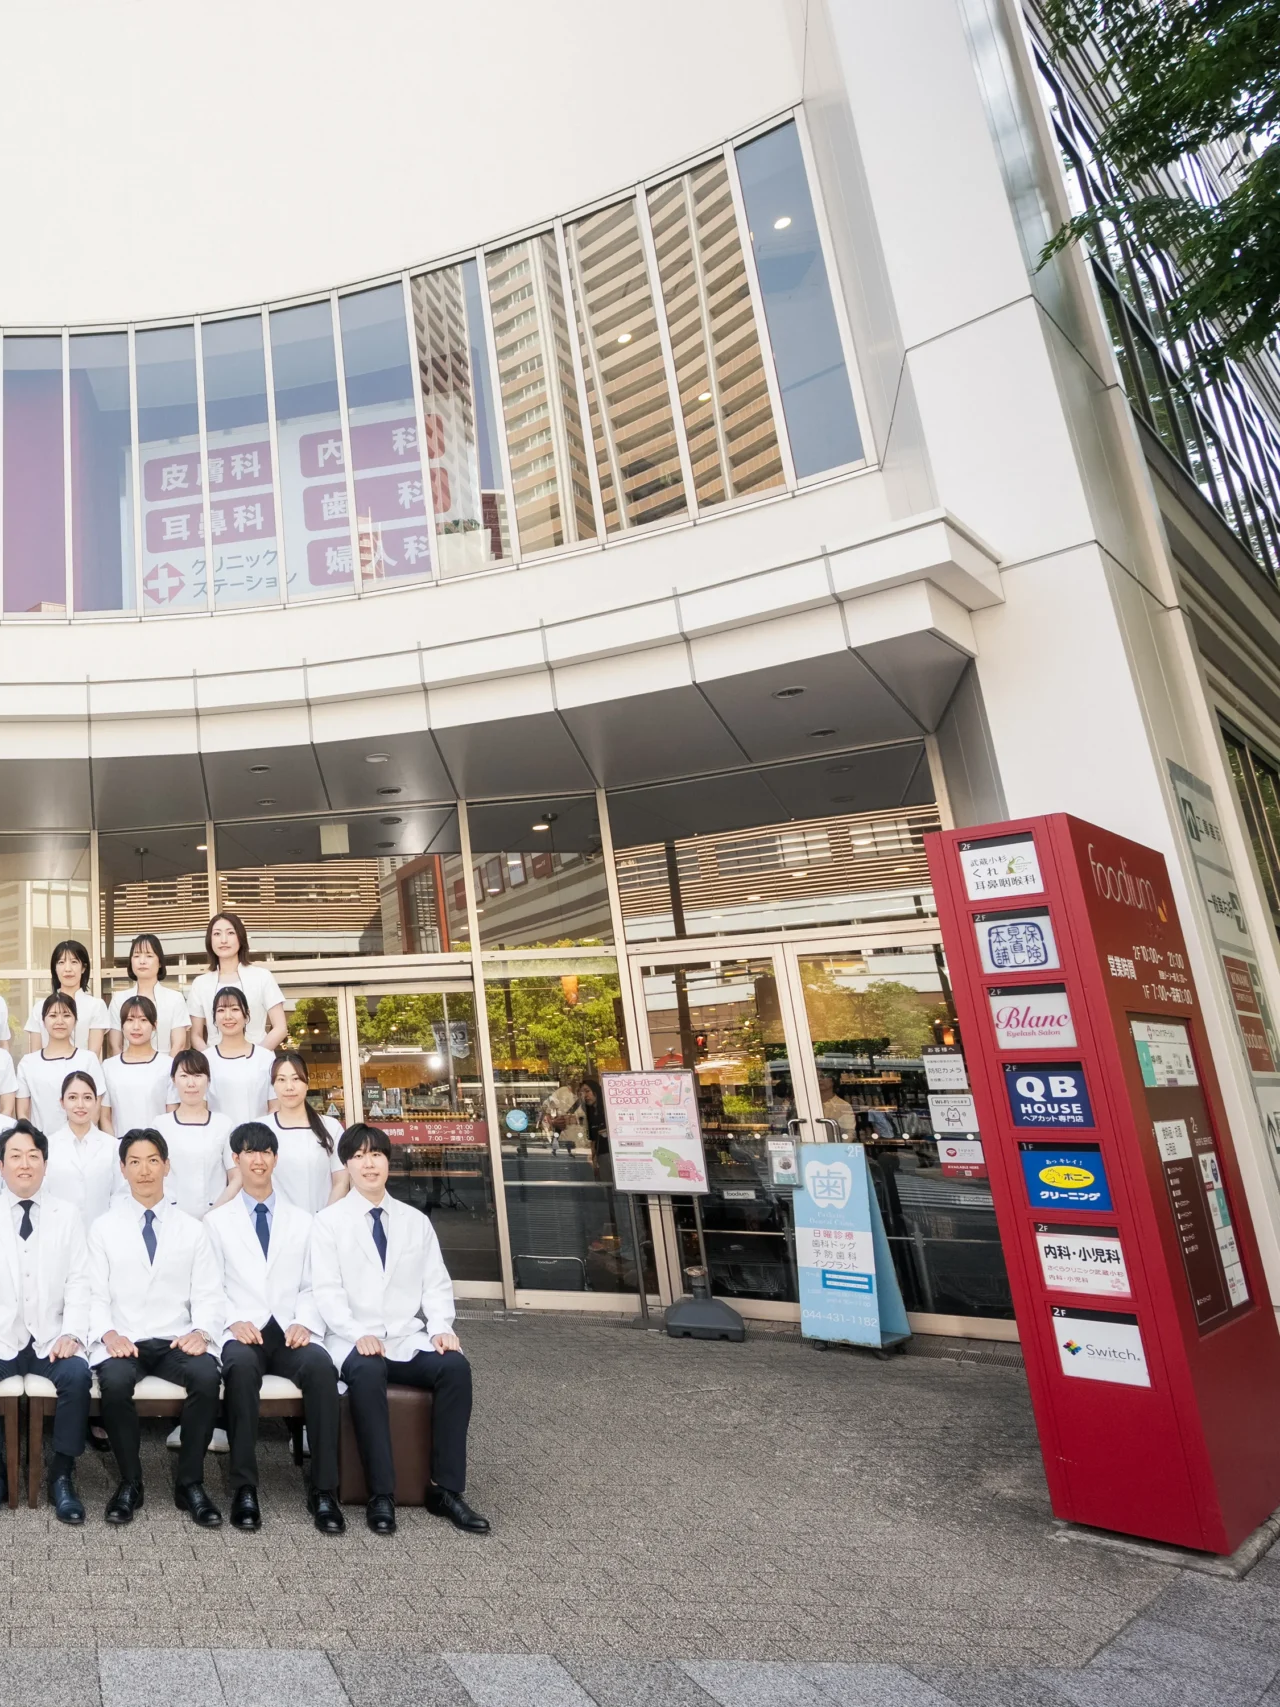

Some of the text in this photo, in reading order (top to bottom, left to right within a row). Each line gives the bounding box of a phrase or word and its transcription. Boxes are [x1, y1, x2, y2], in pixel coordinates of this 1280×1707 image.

[161, 451, 261, 491] 皮膚科
[162, 503, 264, 541] 耳鼻科
[191, 550, 278, 574] クリニック
[961, 843, 971, 851] 2F
[970, 855, 1007, 867] 武蔵小杉
[972, 867, 998, 878] くれ
[1088, 843, 1158, 913] foodium
[974, 874, 1036, 890] 耳鼻咽喉科
[975, 914, 986, 922] 2F
[991, 928, 1011, 965] 本舗
[1007, 925, 1026, 965] 見直し
[1022, 925, 1044, 963] 保険
[1167, 951, 1185, 970] 21:00
[1107, 954, 1138, 981] 営業時間
[990, 988, 1001, 996] 2F
[995, 1006, 1070, 1030] Blanc
[1006, 1030, 1036, 1038] Eyelash
[608, 1079, 662, 1087] ネットスーパーが
[1016, 1076, 1078, 1102] QB
[1020, 1103, 1083, 1114] HOUSE
[847, 1146, 863, 1158] 2F
[1021, 1143, 1034, 1151] 1F
[810, 1168, 847, 1200] 歯
[1039, 1191, 1101, 1201] クリーニング
[1038, 1224, 1048, 1232] 2F
[813, 1229, 854, 1240] 日曜診療
[813, 1249, 857, 1261] 予防歯科
[1044, 1244, 1120, 1264] 内科・小児科
[813, 1260, 858, 1270] インプラント
[1047, 1265, 1124, 1277] さくらクリニック武蔵小杉
[802, 1309, 878, 1328] 044-431-1182
[1052, 1308, 1066, 1317] 2F
